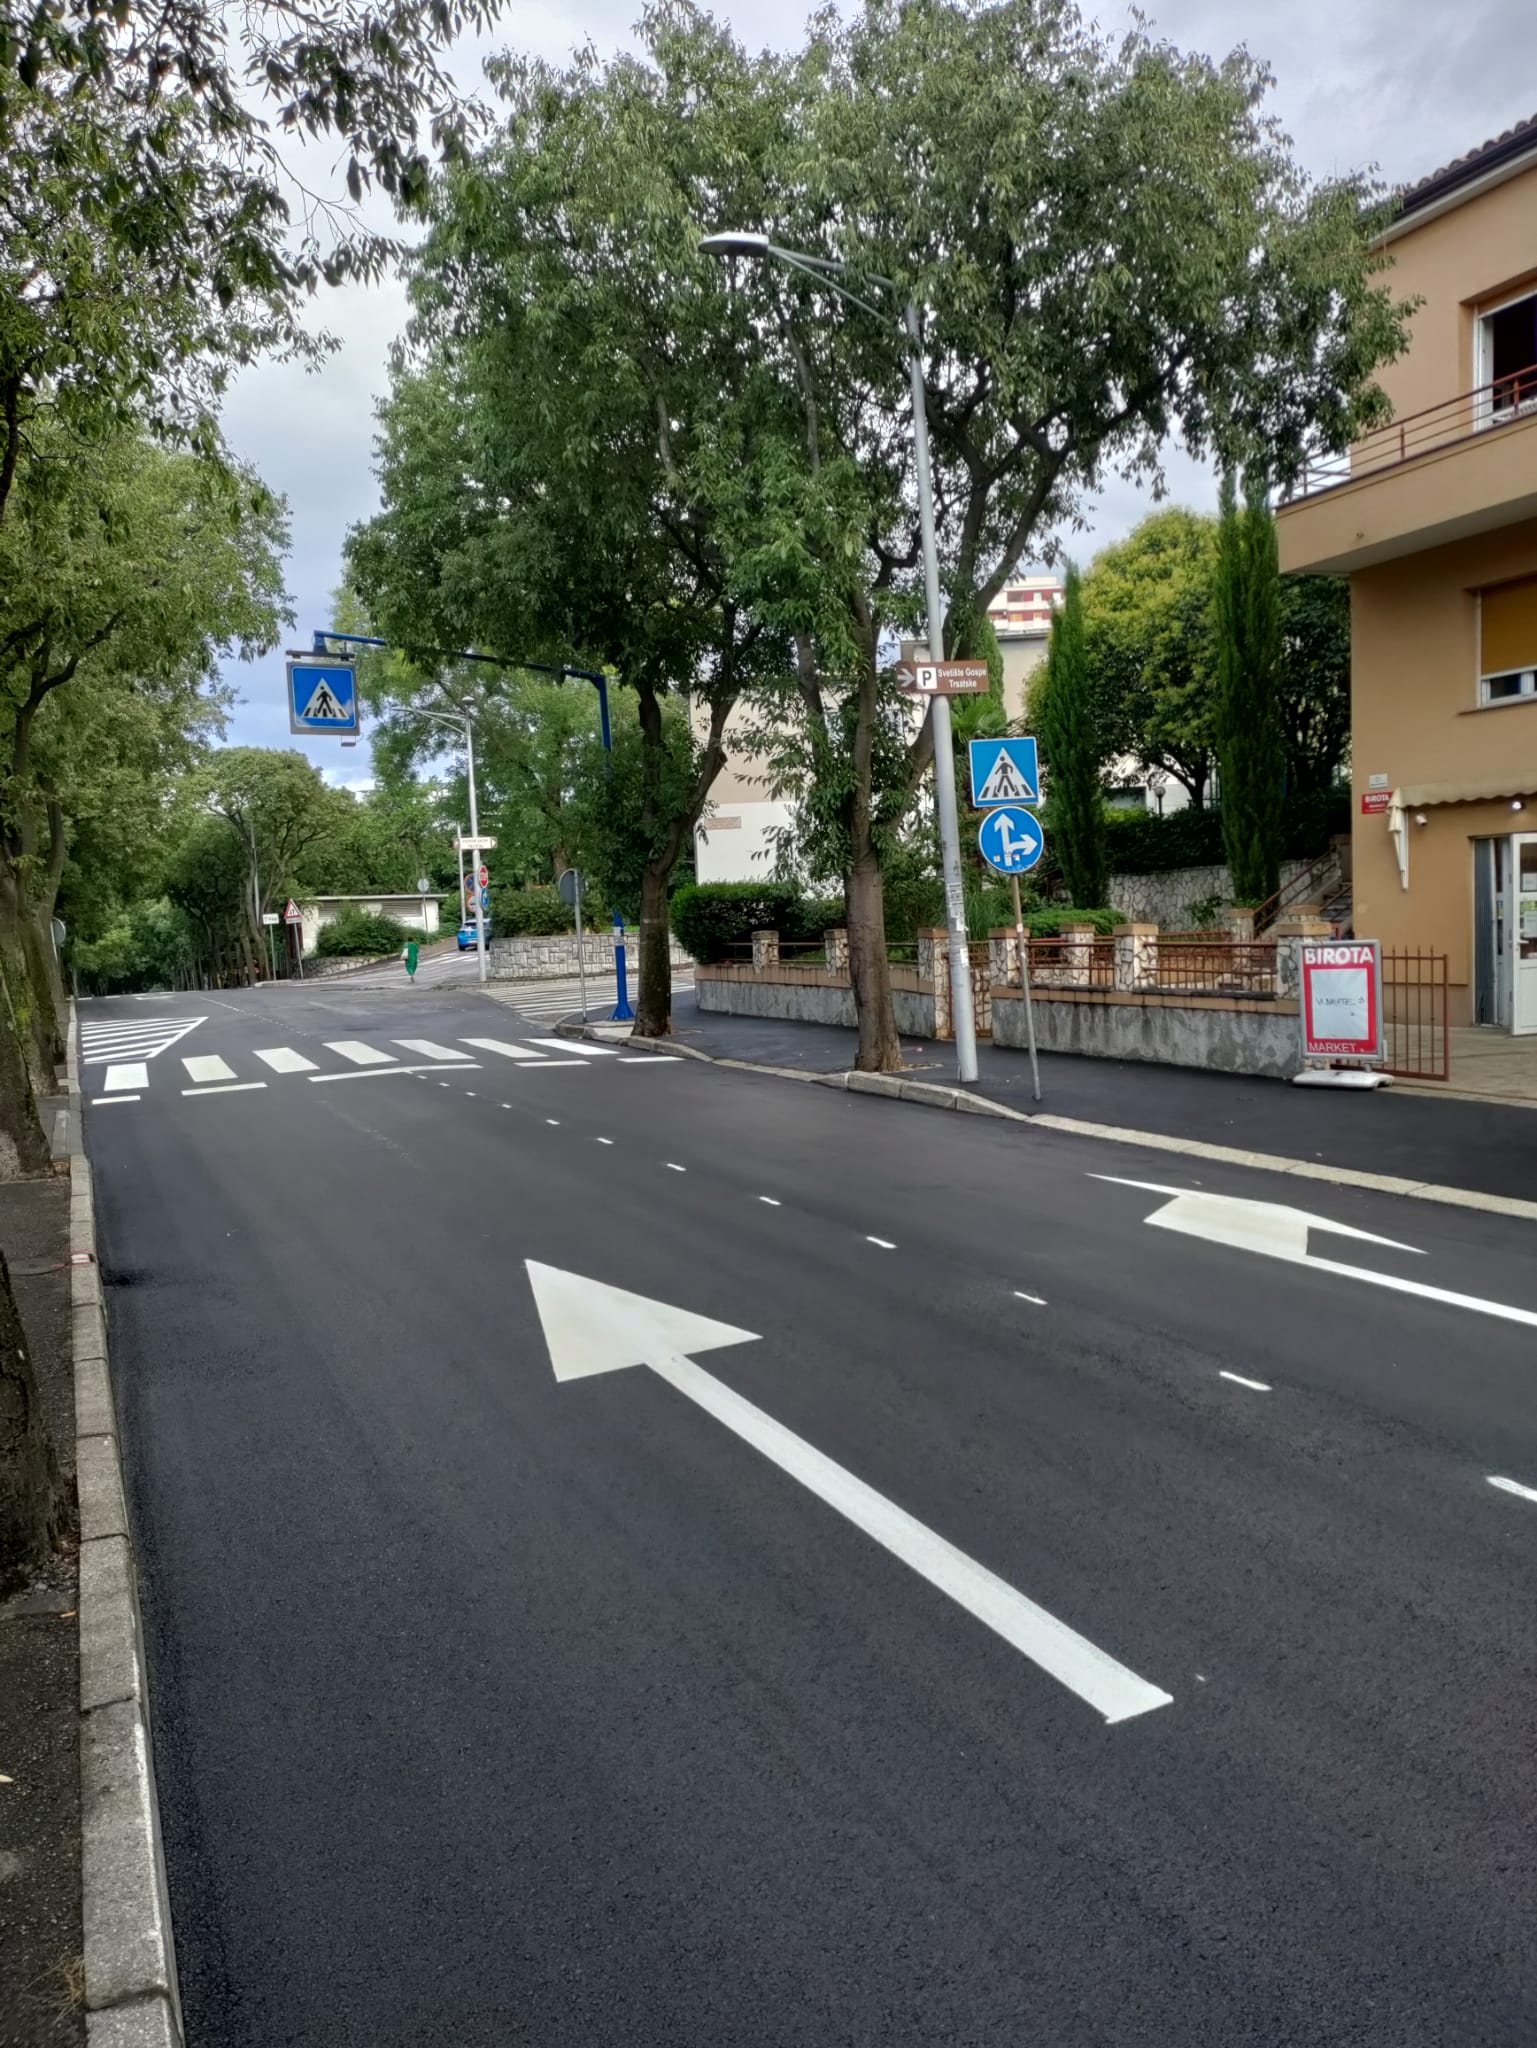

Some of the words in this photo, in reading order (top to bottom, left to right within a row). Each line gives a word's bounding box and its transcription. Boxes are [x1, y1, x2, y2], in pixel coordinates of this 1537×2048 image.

[937, 668, 964, 677] Svetište
[965, 667, 986, 677] Gospe
[922, 670, 932, 686] P
[949, 679, 976, 688] Trsatske
[1304, 947, 1374, 965] BIROTA
[1308, 1042, 1357, 1053] MARKET
